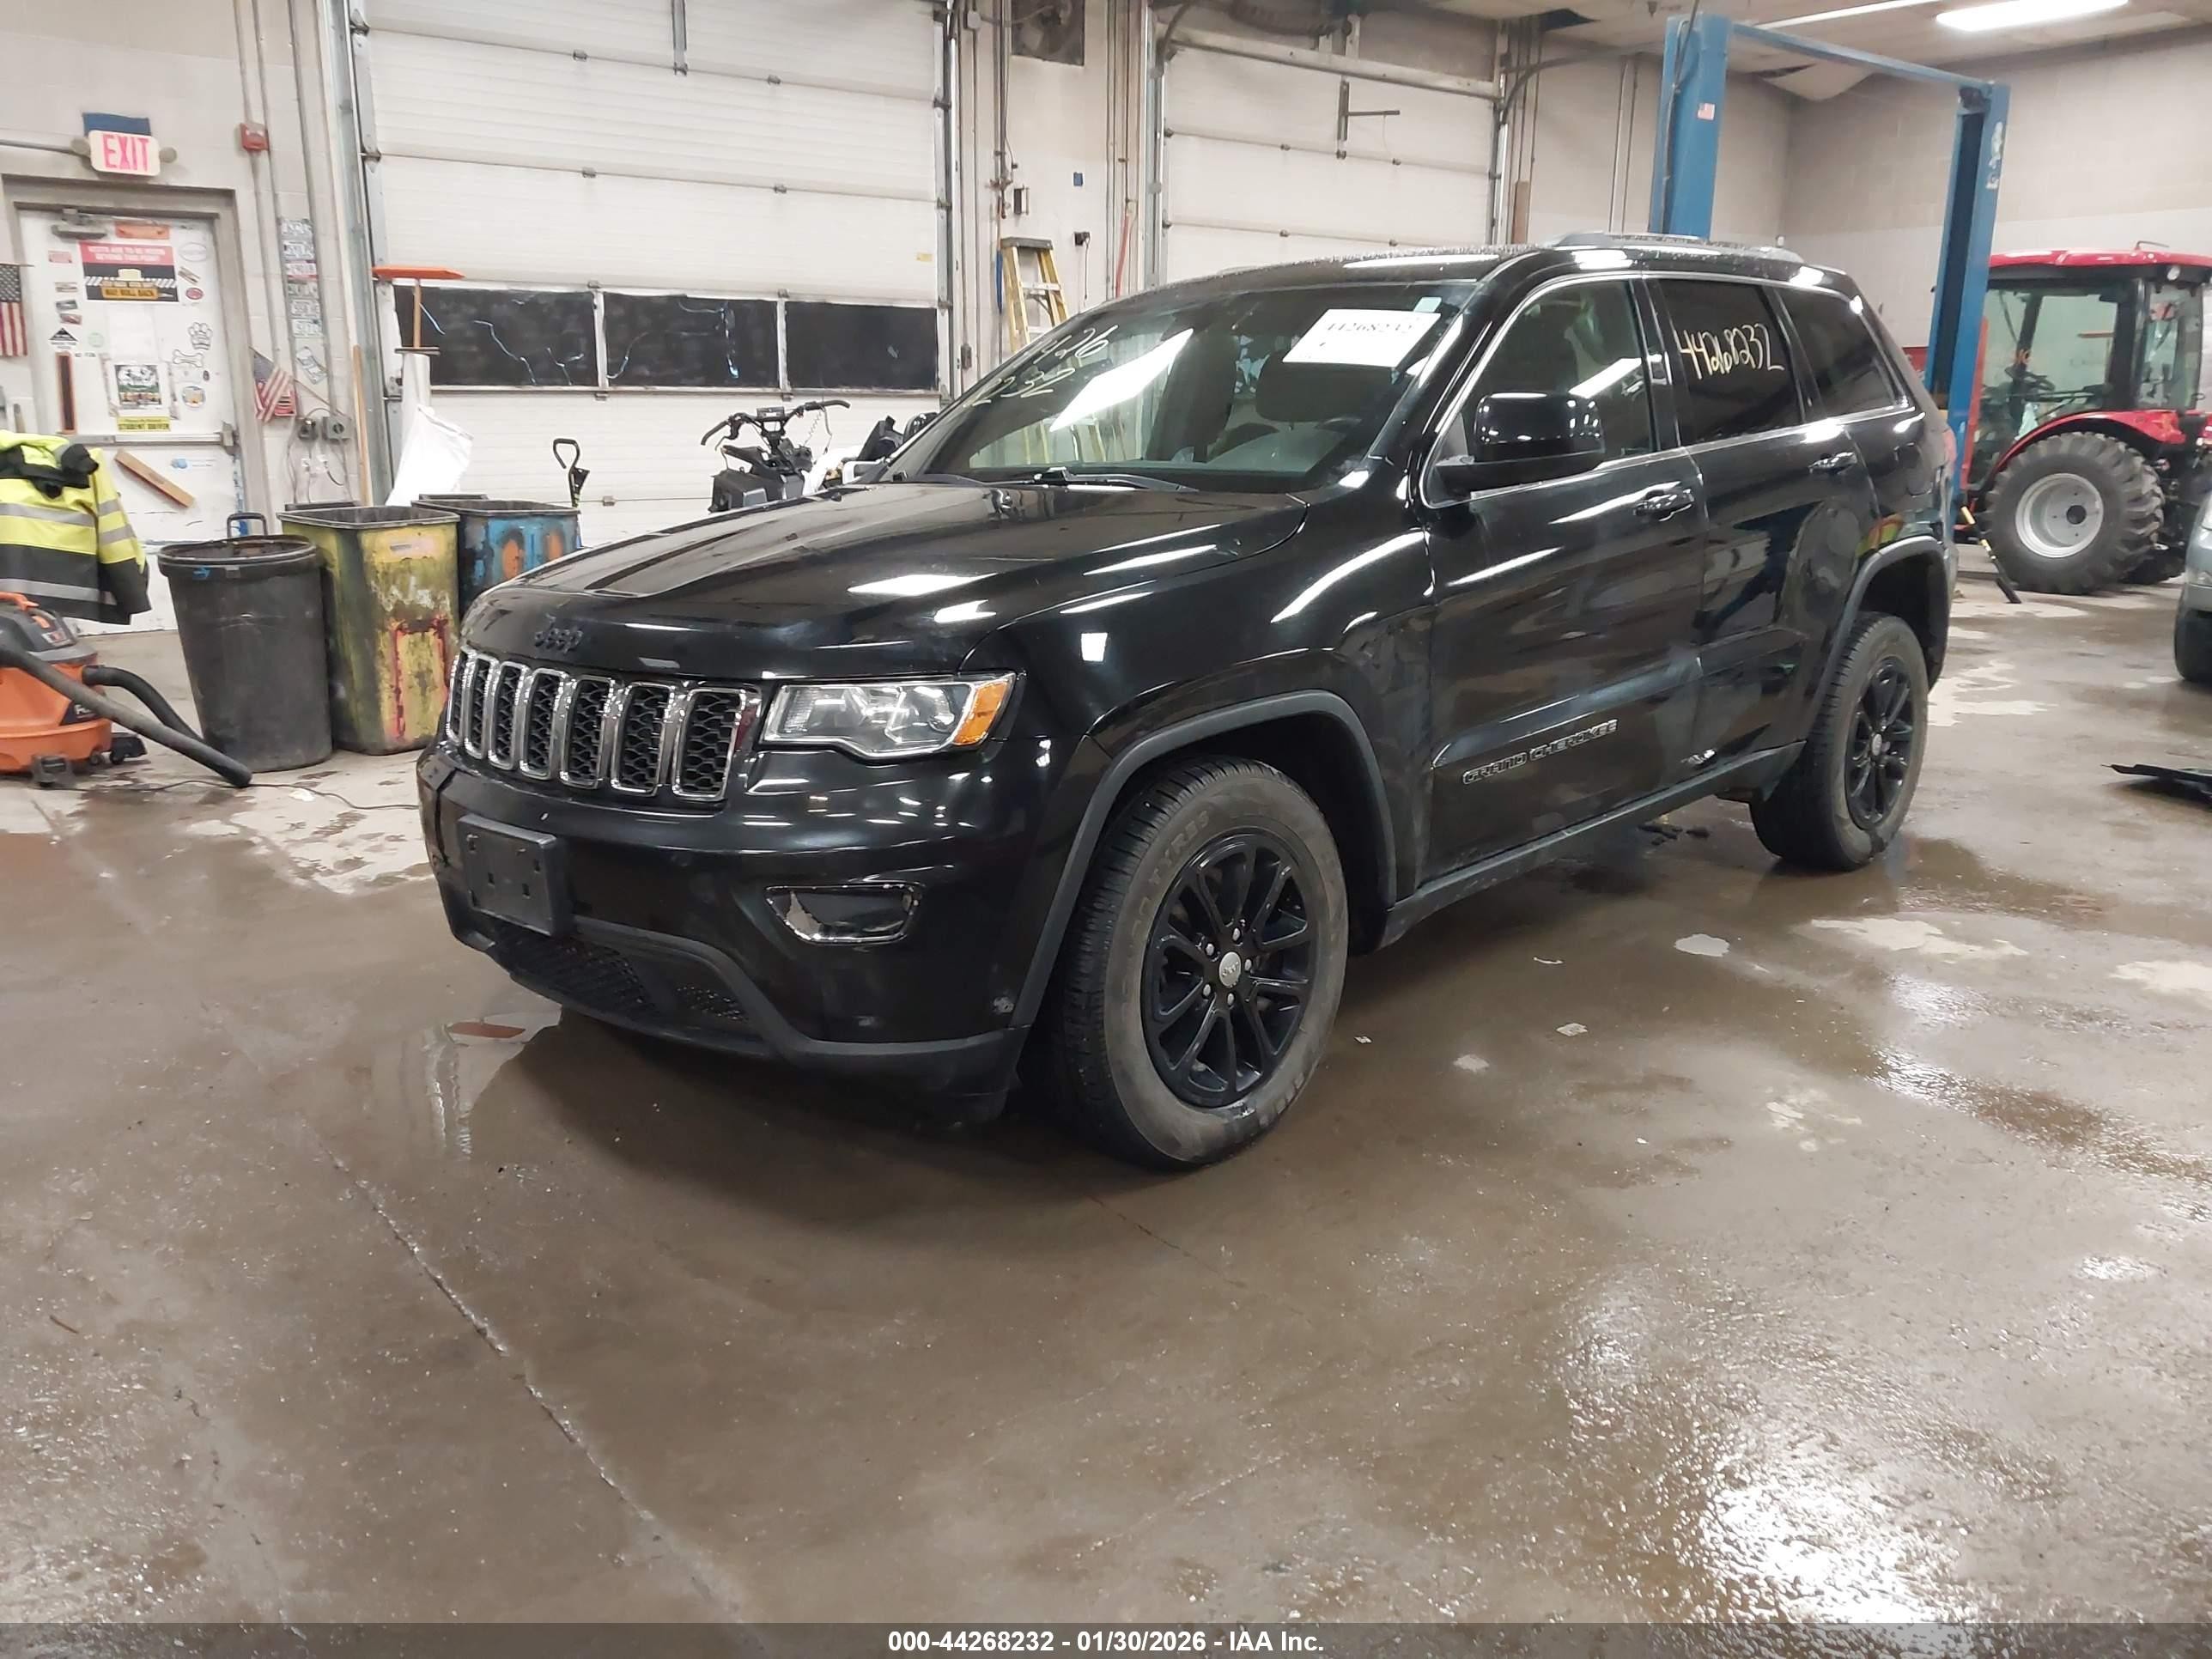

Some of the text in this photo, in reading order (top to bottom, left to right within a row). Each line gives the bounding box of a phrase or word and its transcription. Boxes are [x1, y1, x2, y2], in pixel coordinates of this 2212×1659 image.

[102, 133, 149, 172] EXIT
[1679, 322, 1785, 380] 44268232
[1462, 718, 1619, 785] GRAND CHEROKEE
